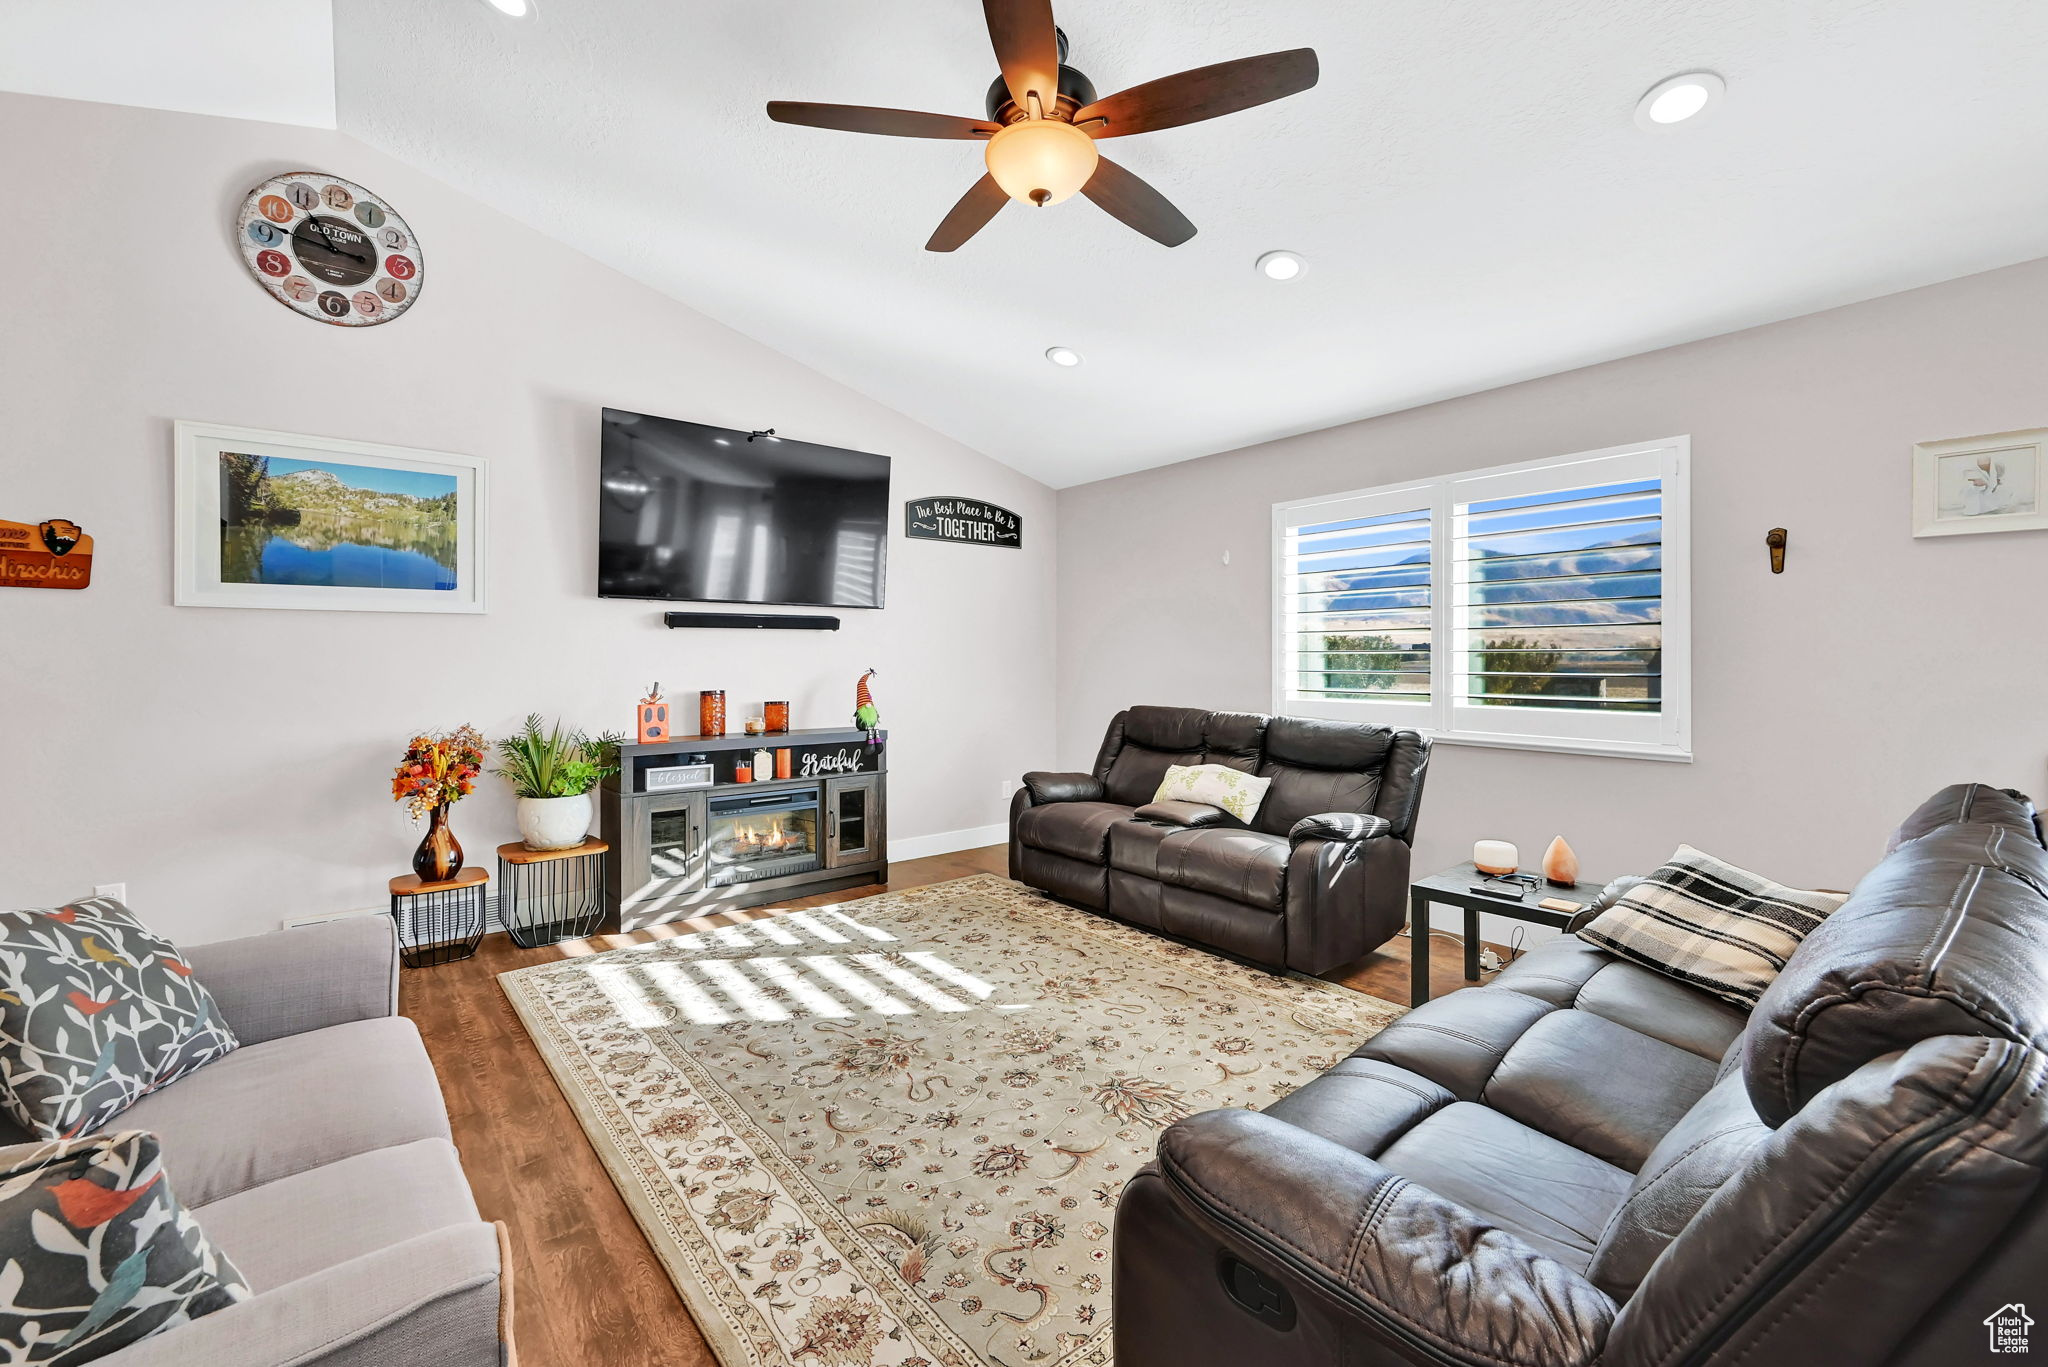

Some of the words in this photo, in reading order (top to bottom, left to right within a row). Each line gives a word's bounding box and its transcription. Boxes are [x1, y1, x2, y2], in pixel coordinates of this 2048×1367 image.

[294, 187, 312, 206] 11
[328, 188, 349, 209] 12
[265, 199, 289, 219] 10
[366, 207, 373, 224] 1
[258, 224, 274, 242] 9
[310, 223, 330, 235] OLD
[333, 229, 362, 244] TOWN
[326, 234, 347, 244] LOCKS
[386, 230, 399, 249] 2
[265, 254, 283, 273] 8
[392, 258, 409, 276] 3
[291, 282, 309, 299] 7
[382, 283, 399, 299] 4
[326, 296, 341, 313] 6
[360, 296, 375, 313] 5
[915, 505, 933, 519] The
[933, 501, 955, 515] Best
[956, 501, 981, 517] Place
[984, 505, 993, 519] To
[995, 509, 1006, 525] Be
[1007, 515, 1016, 529] Is
[936, 517, 995, 541] TOGETHER
[800, 748, 864, 776] grateful
[657, 769, 701, 784] blessed
